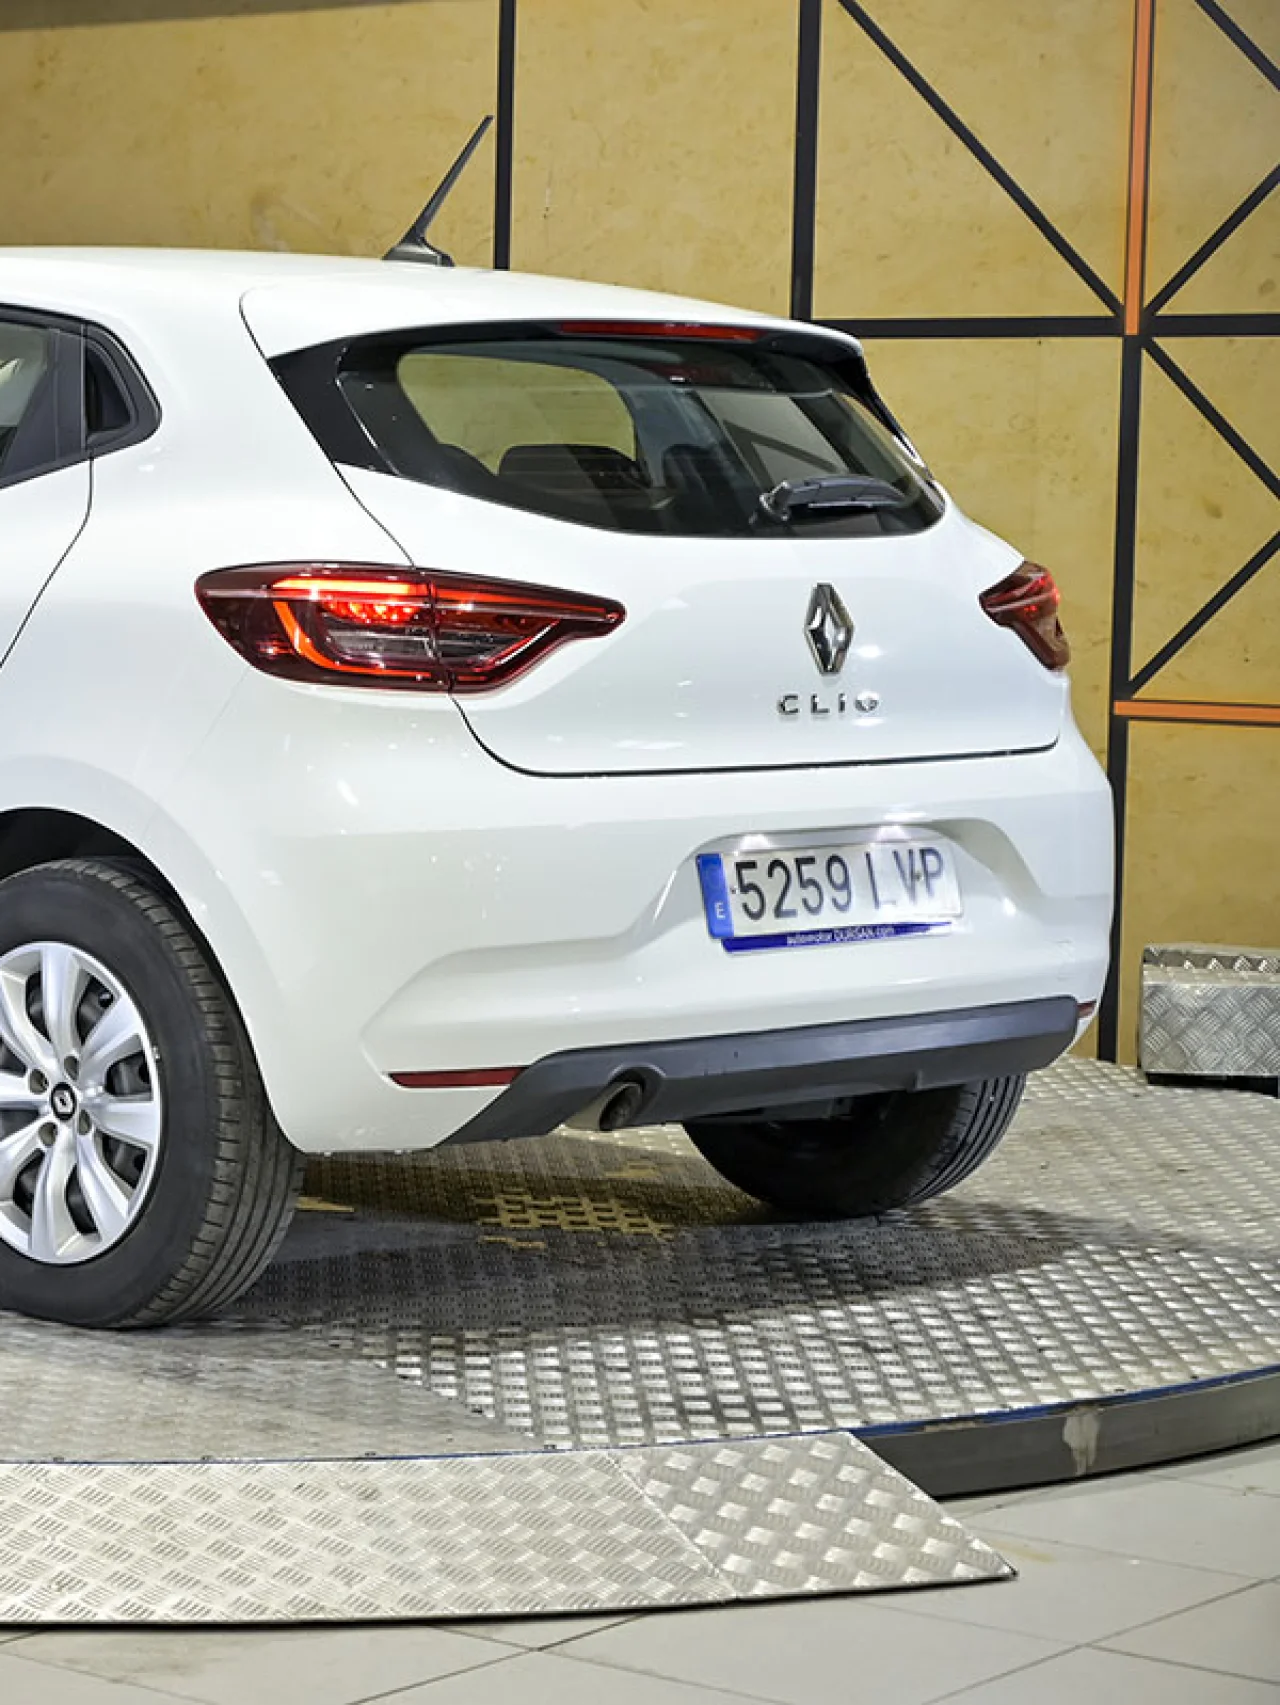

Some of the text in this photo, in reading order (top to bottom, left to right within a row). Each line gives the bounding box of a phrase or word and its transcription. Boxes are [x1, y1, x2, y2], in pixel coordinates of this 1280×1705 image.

[733, 847, 944, 921] 5259 LVP
[714, 901, 726, 919] E
